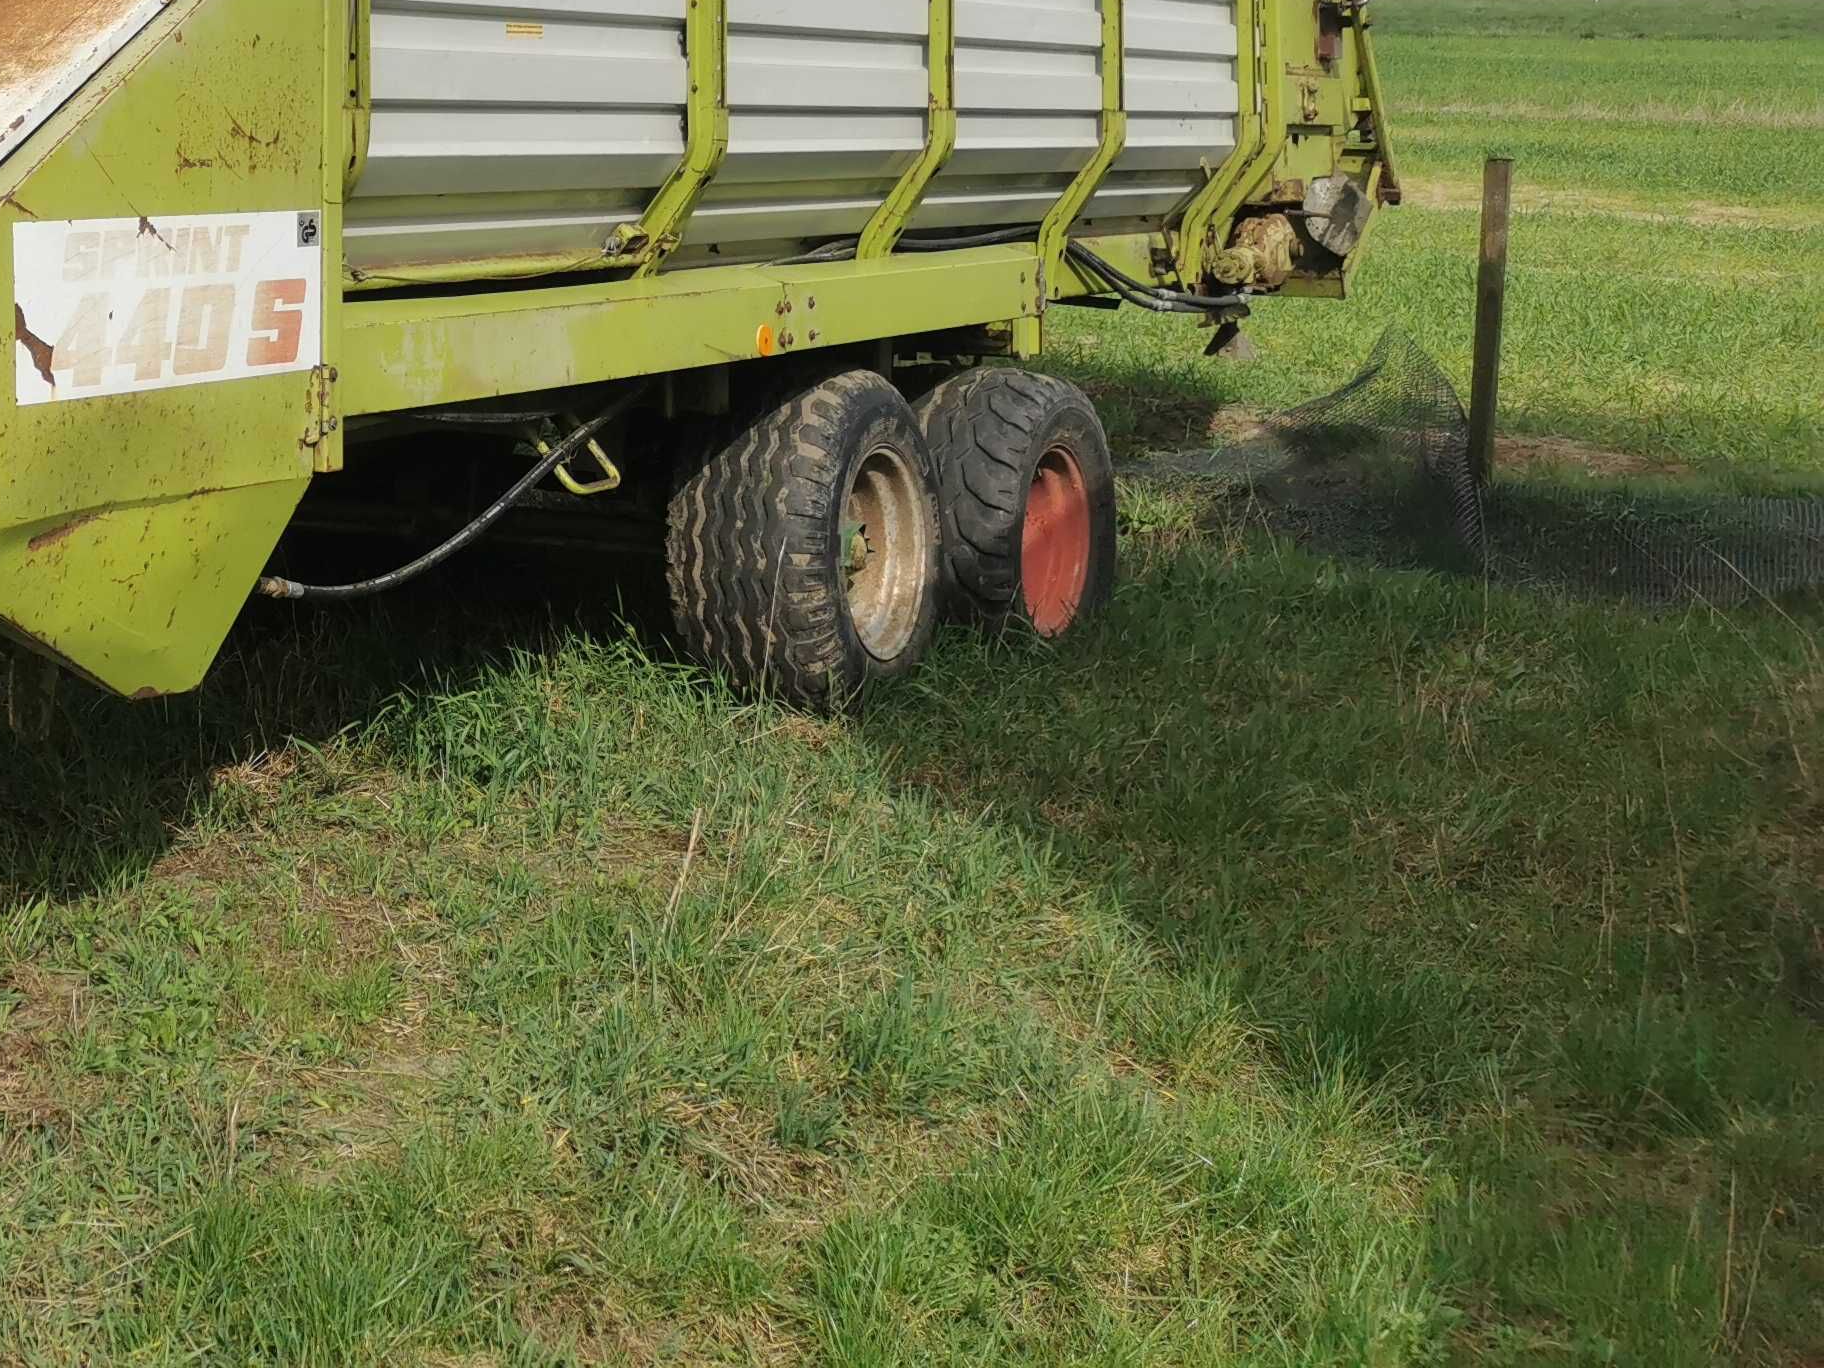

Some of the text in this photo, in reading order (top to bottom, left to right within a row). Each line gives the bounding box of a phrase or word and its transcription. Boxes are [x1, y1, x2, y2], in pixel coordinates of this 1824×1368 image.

[62, 224, 250, 280] SPRINT
[52, 278, 307, 387] 440 S
